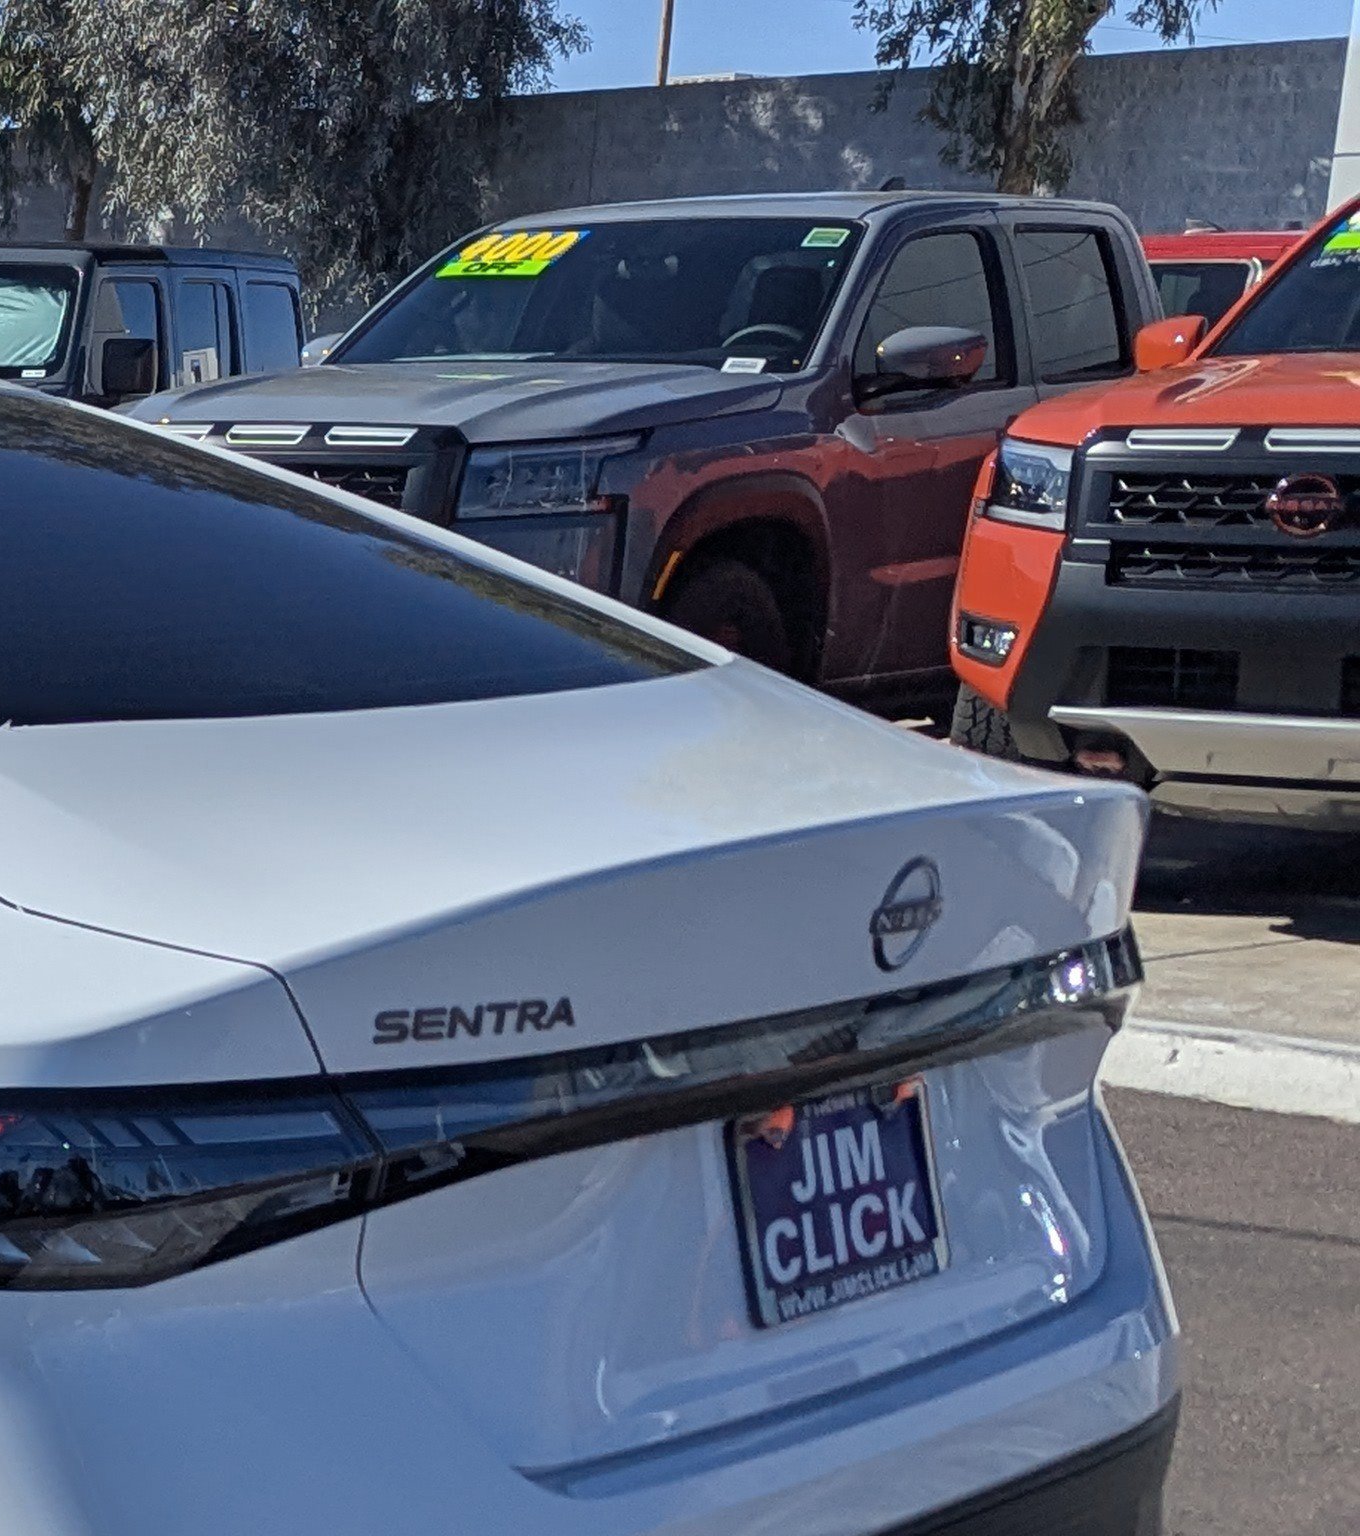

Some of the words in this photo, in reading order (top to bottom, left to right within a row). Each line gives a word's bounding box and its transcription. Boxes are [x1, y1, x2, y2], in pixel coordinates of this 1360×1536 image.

[462, 261, 524, 273] OFF
[373, 996, 574, 1044] SENTRA
[791, 1120, 885, 1203] JIM
[764, 1182, 926, 1284] CLICK
